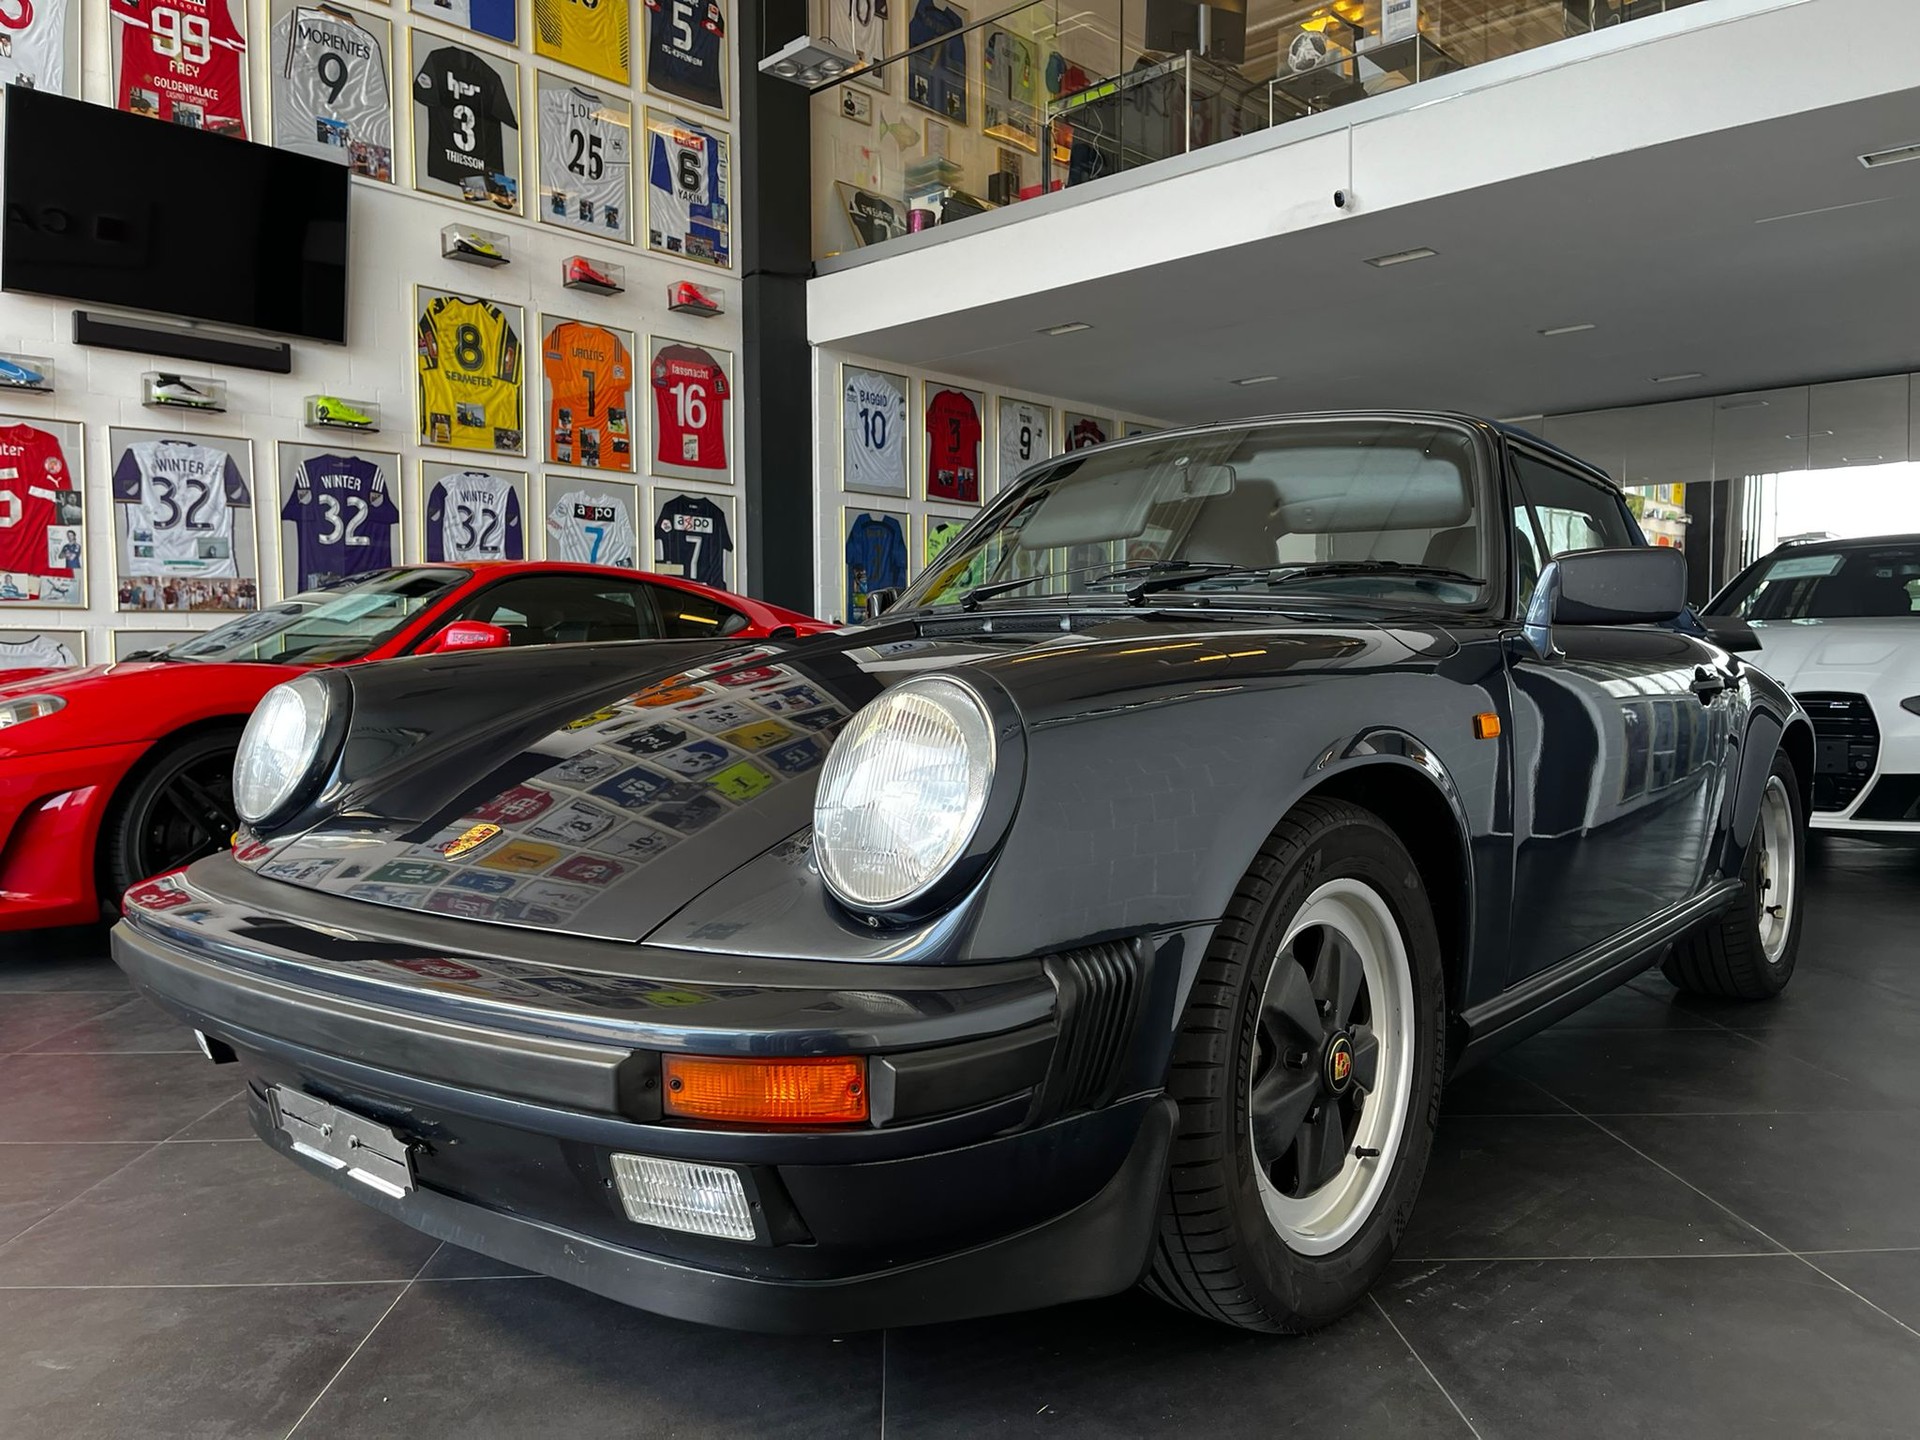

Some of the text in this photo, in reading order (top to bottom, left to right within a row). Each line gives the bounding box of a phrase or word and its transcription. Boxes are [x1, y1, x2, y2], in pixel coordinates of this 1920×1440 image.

[151, 6, 210, 65] 99
[298, 25, 370, 60] MORIENTES
[673, 1, 692, 51] 5
[153, 75, 219, 100] GOLDENPALACE
[169, 60, 200, 78] FREY
[318, 52, 349, 105] 9
[453, 104, 476, 152] 3
[568, 128, 603, 180] 25
[677, 148, 702, 194] 6
[678, 188, 703, 204] YAKIN
[455, 323, 485, 372] 8
[582, 370, 595, 417] 1
[669, 382, 707, 429] 16
[860, 390, 888, 407] BAGGIO
[859, 408, 886, 449] 10
[1020, 426, 1031, 460] 9
[156, 459, 205, 475] WINTER
[321, 474, 361, 491] WINTER
[152, 476, 215, 531] 32
[319, 494, 370, 546] 32
[461, 491, 494, 505] WINTER
[456, 505, 500, 553] 32
[585, 526, 603, 564] 7
[685, 535, 702, 579] 7
[1236, 981, 1258, 1135] MICHELIN
